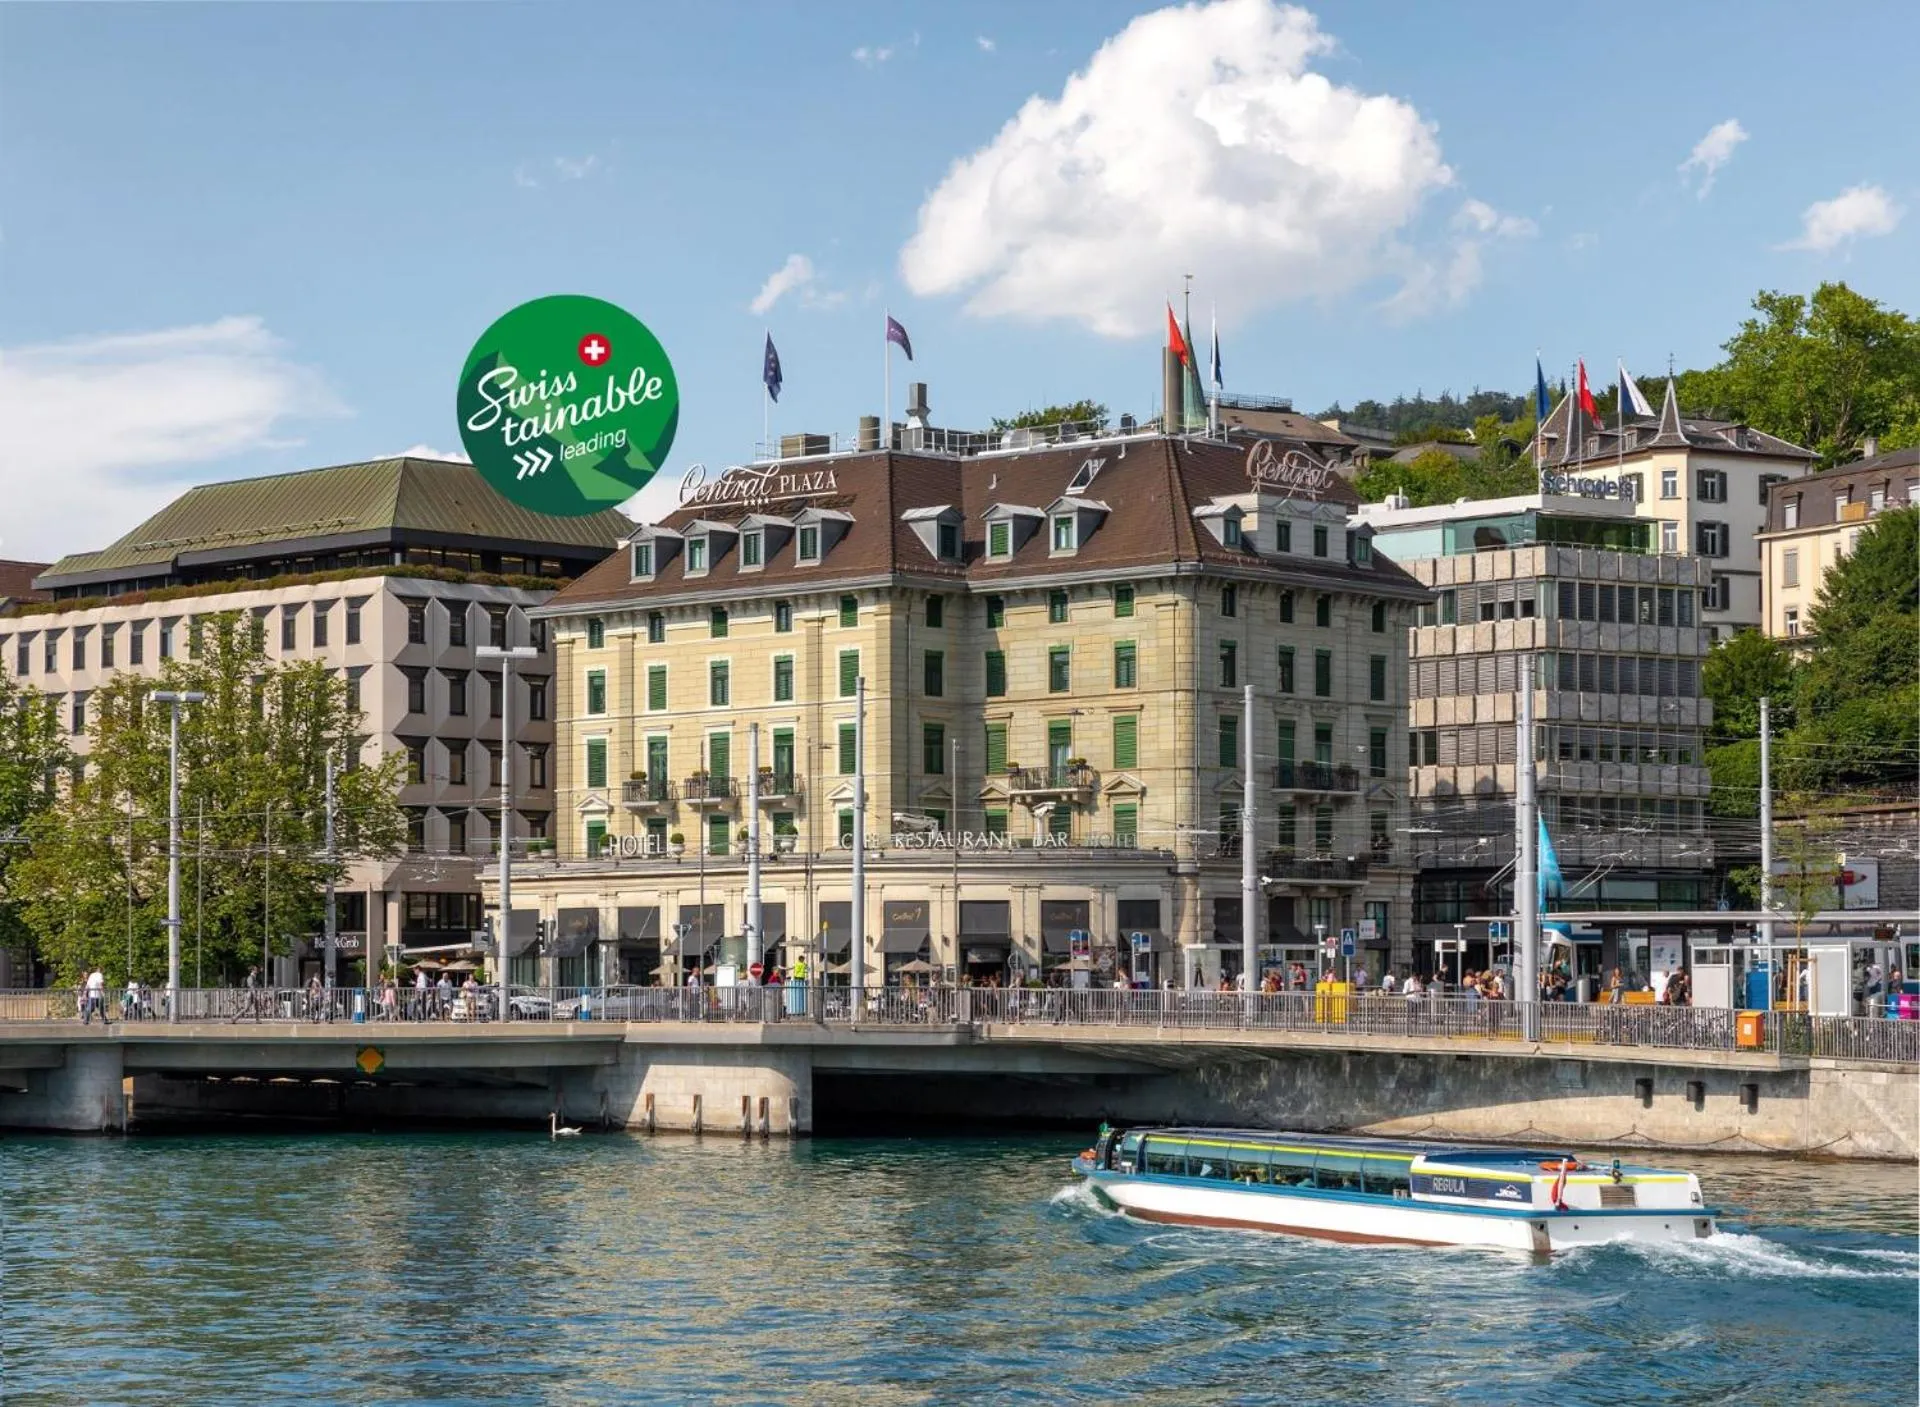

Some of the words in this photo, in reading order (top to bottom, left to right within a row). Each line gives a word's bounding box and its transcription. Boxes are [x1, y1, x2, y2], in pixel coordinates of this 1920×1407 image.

[679, 463, 780, 503] Central
[779, 470, 838, 494] PLAZA
[608, 833, 668, 856] HOTEL
[894, 831, 1014, 849] RESTAURANT
[1032, 831, 1068, 848] BAR
[1432, 1177, 1466, 1194] REGULA
